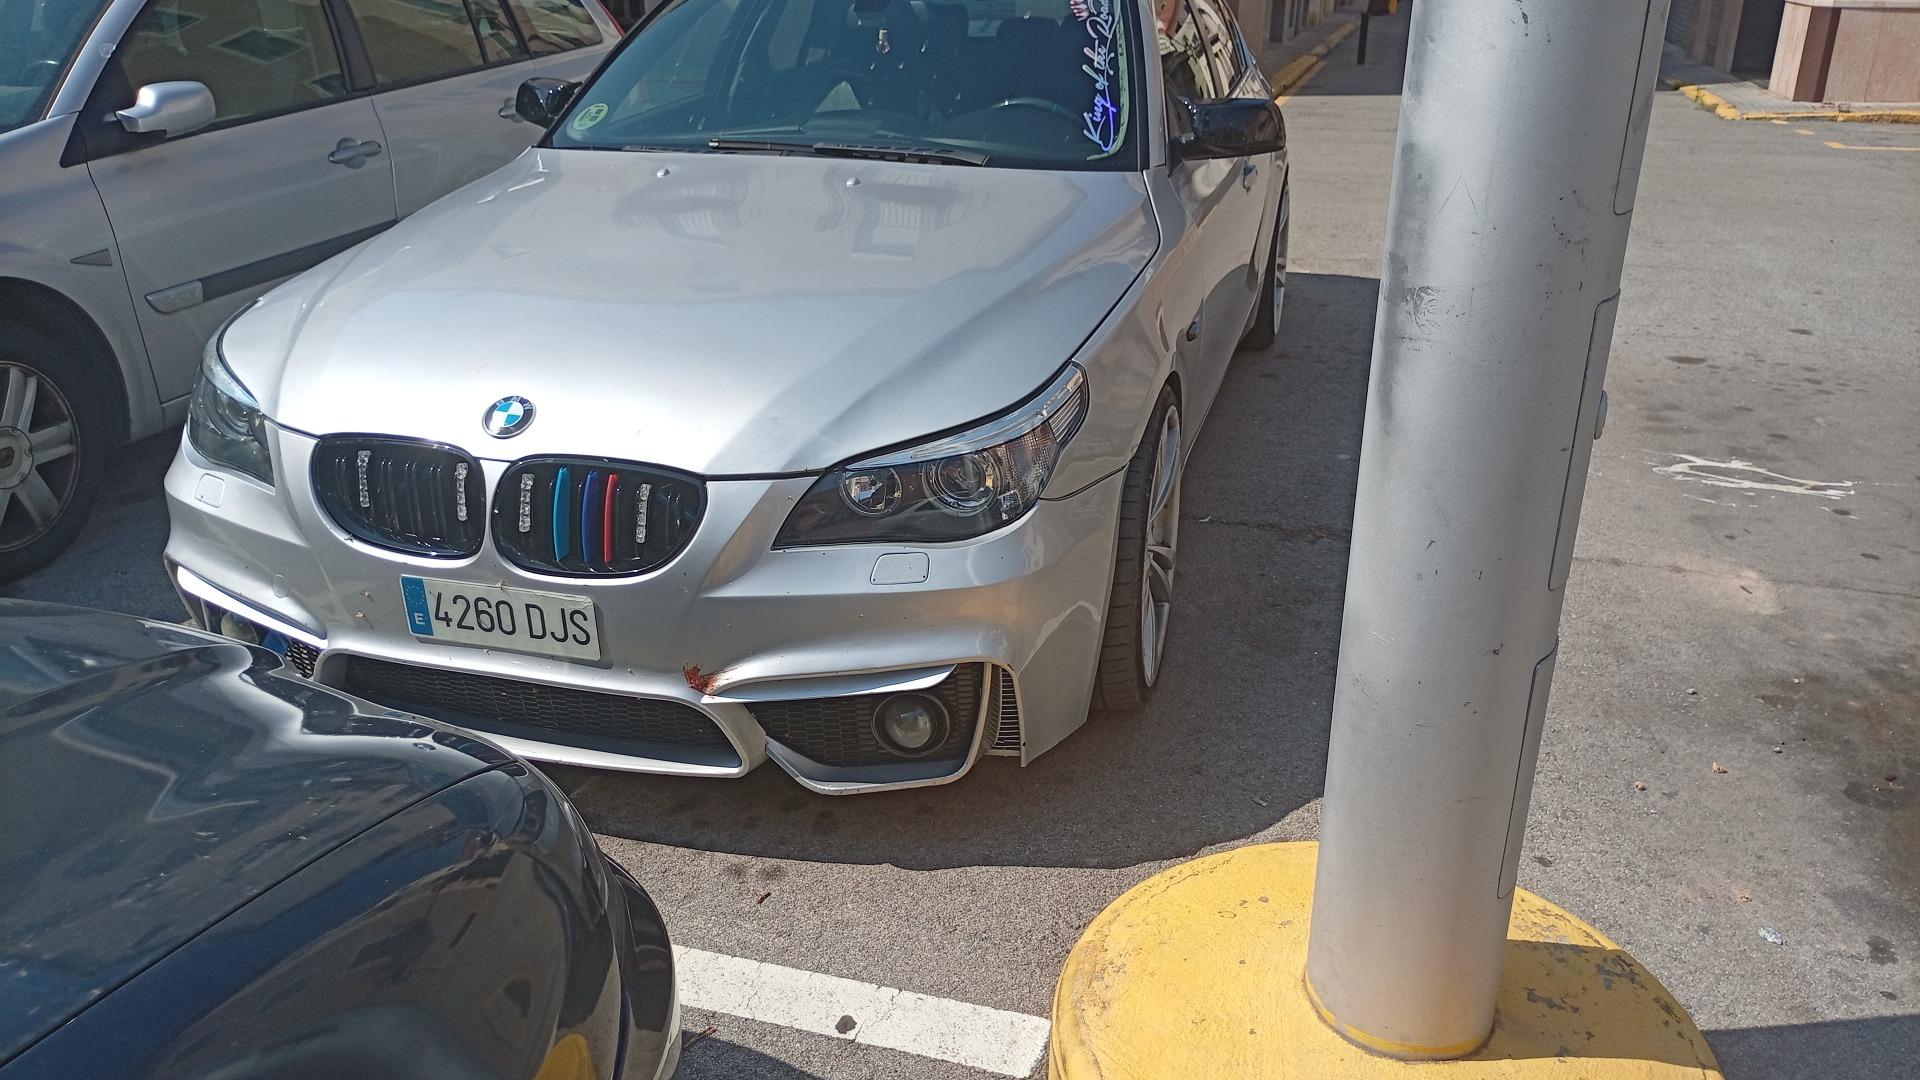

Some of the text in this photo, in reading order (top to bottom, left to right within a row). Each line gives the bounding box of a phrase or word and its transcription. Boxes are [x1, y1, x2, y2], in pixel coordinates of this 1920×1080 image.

[1083, 39, 1106, 70] the
[1082, 64, 1109, 90] of
[1083, 93, 1116, 147] King
[414, 612, 426, 626] E
[434, 592, 591, 646] 4260 DJS
